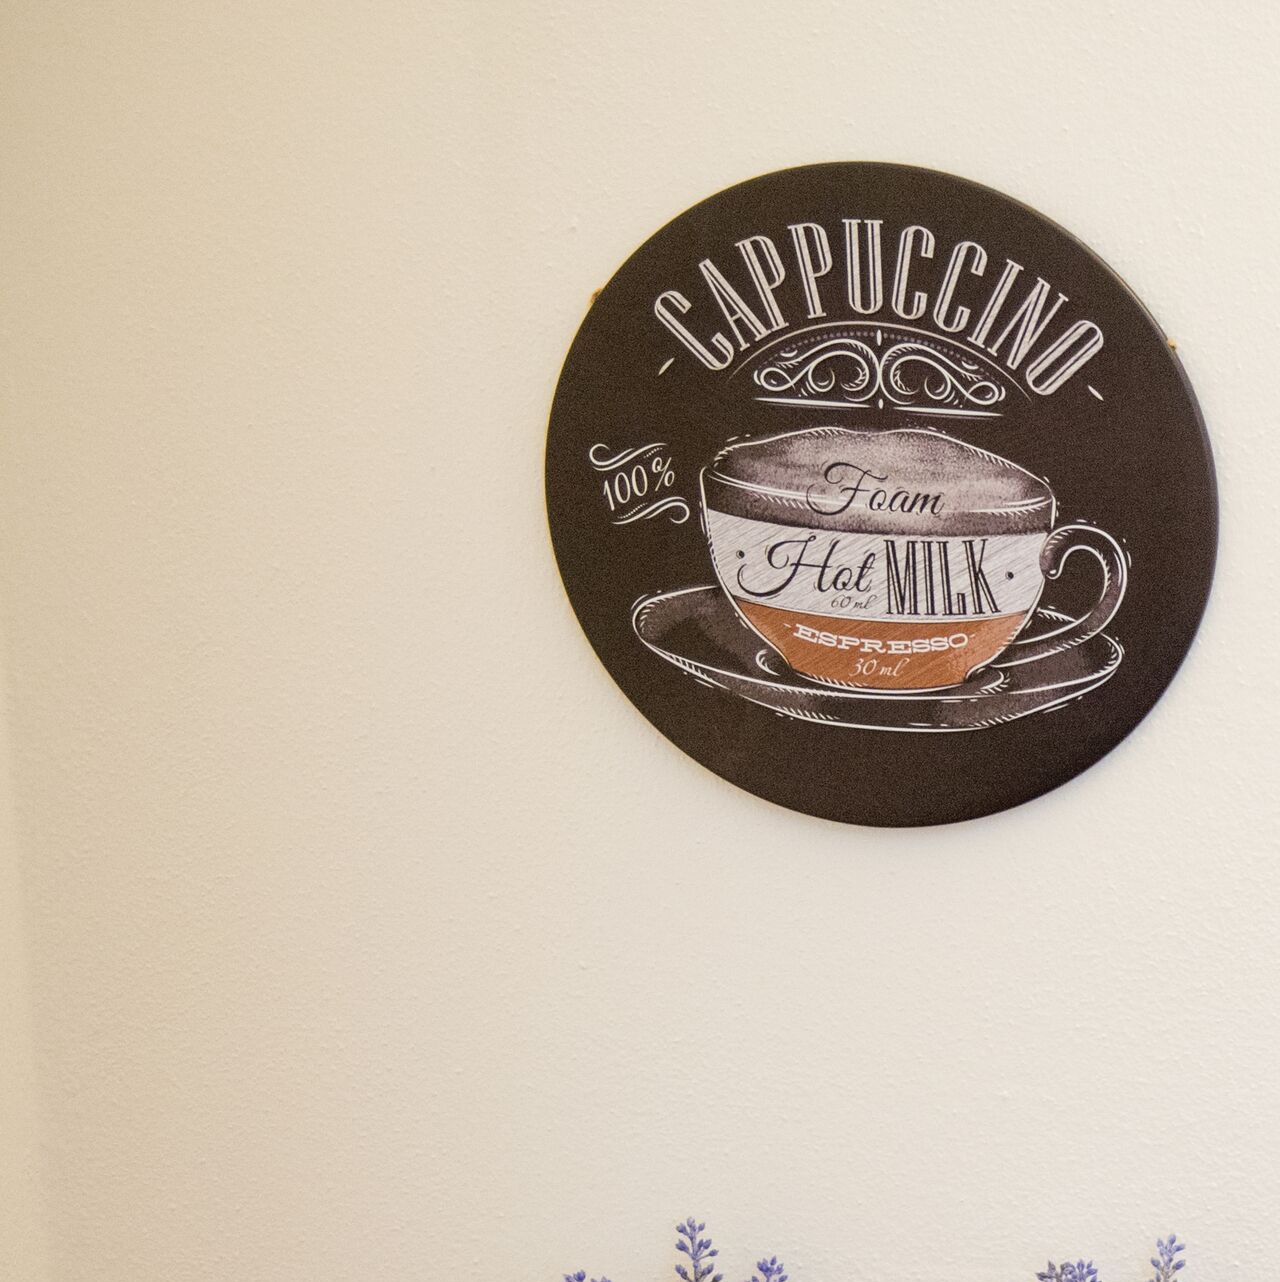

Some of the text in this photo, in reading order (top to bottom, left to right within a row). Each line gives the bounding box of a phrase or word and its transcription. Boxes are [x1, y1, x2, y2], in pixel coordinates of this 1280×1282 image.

[654, 219, 1104, 396] CAPPUCCINO
[602, 456, 676, 511] 100%
[806, 462, 945, 516] Foam
[737, 535, 1001, 616] Hot MILK
[793, 623, 969, 655] ESPRESSO
